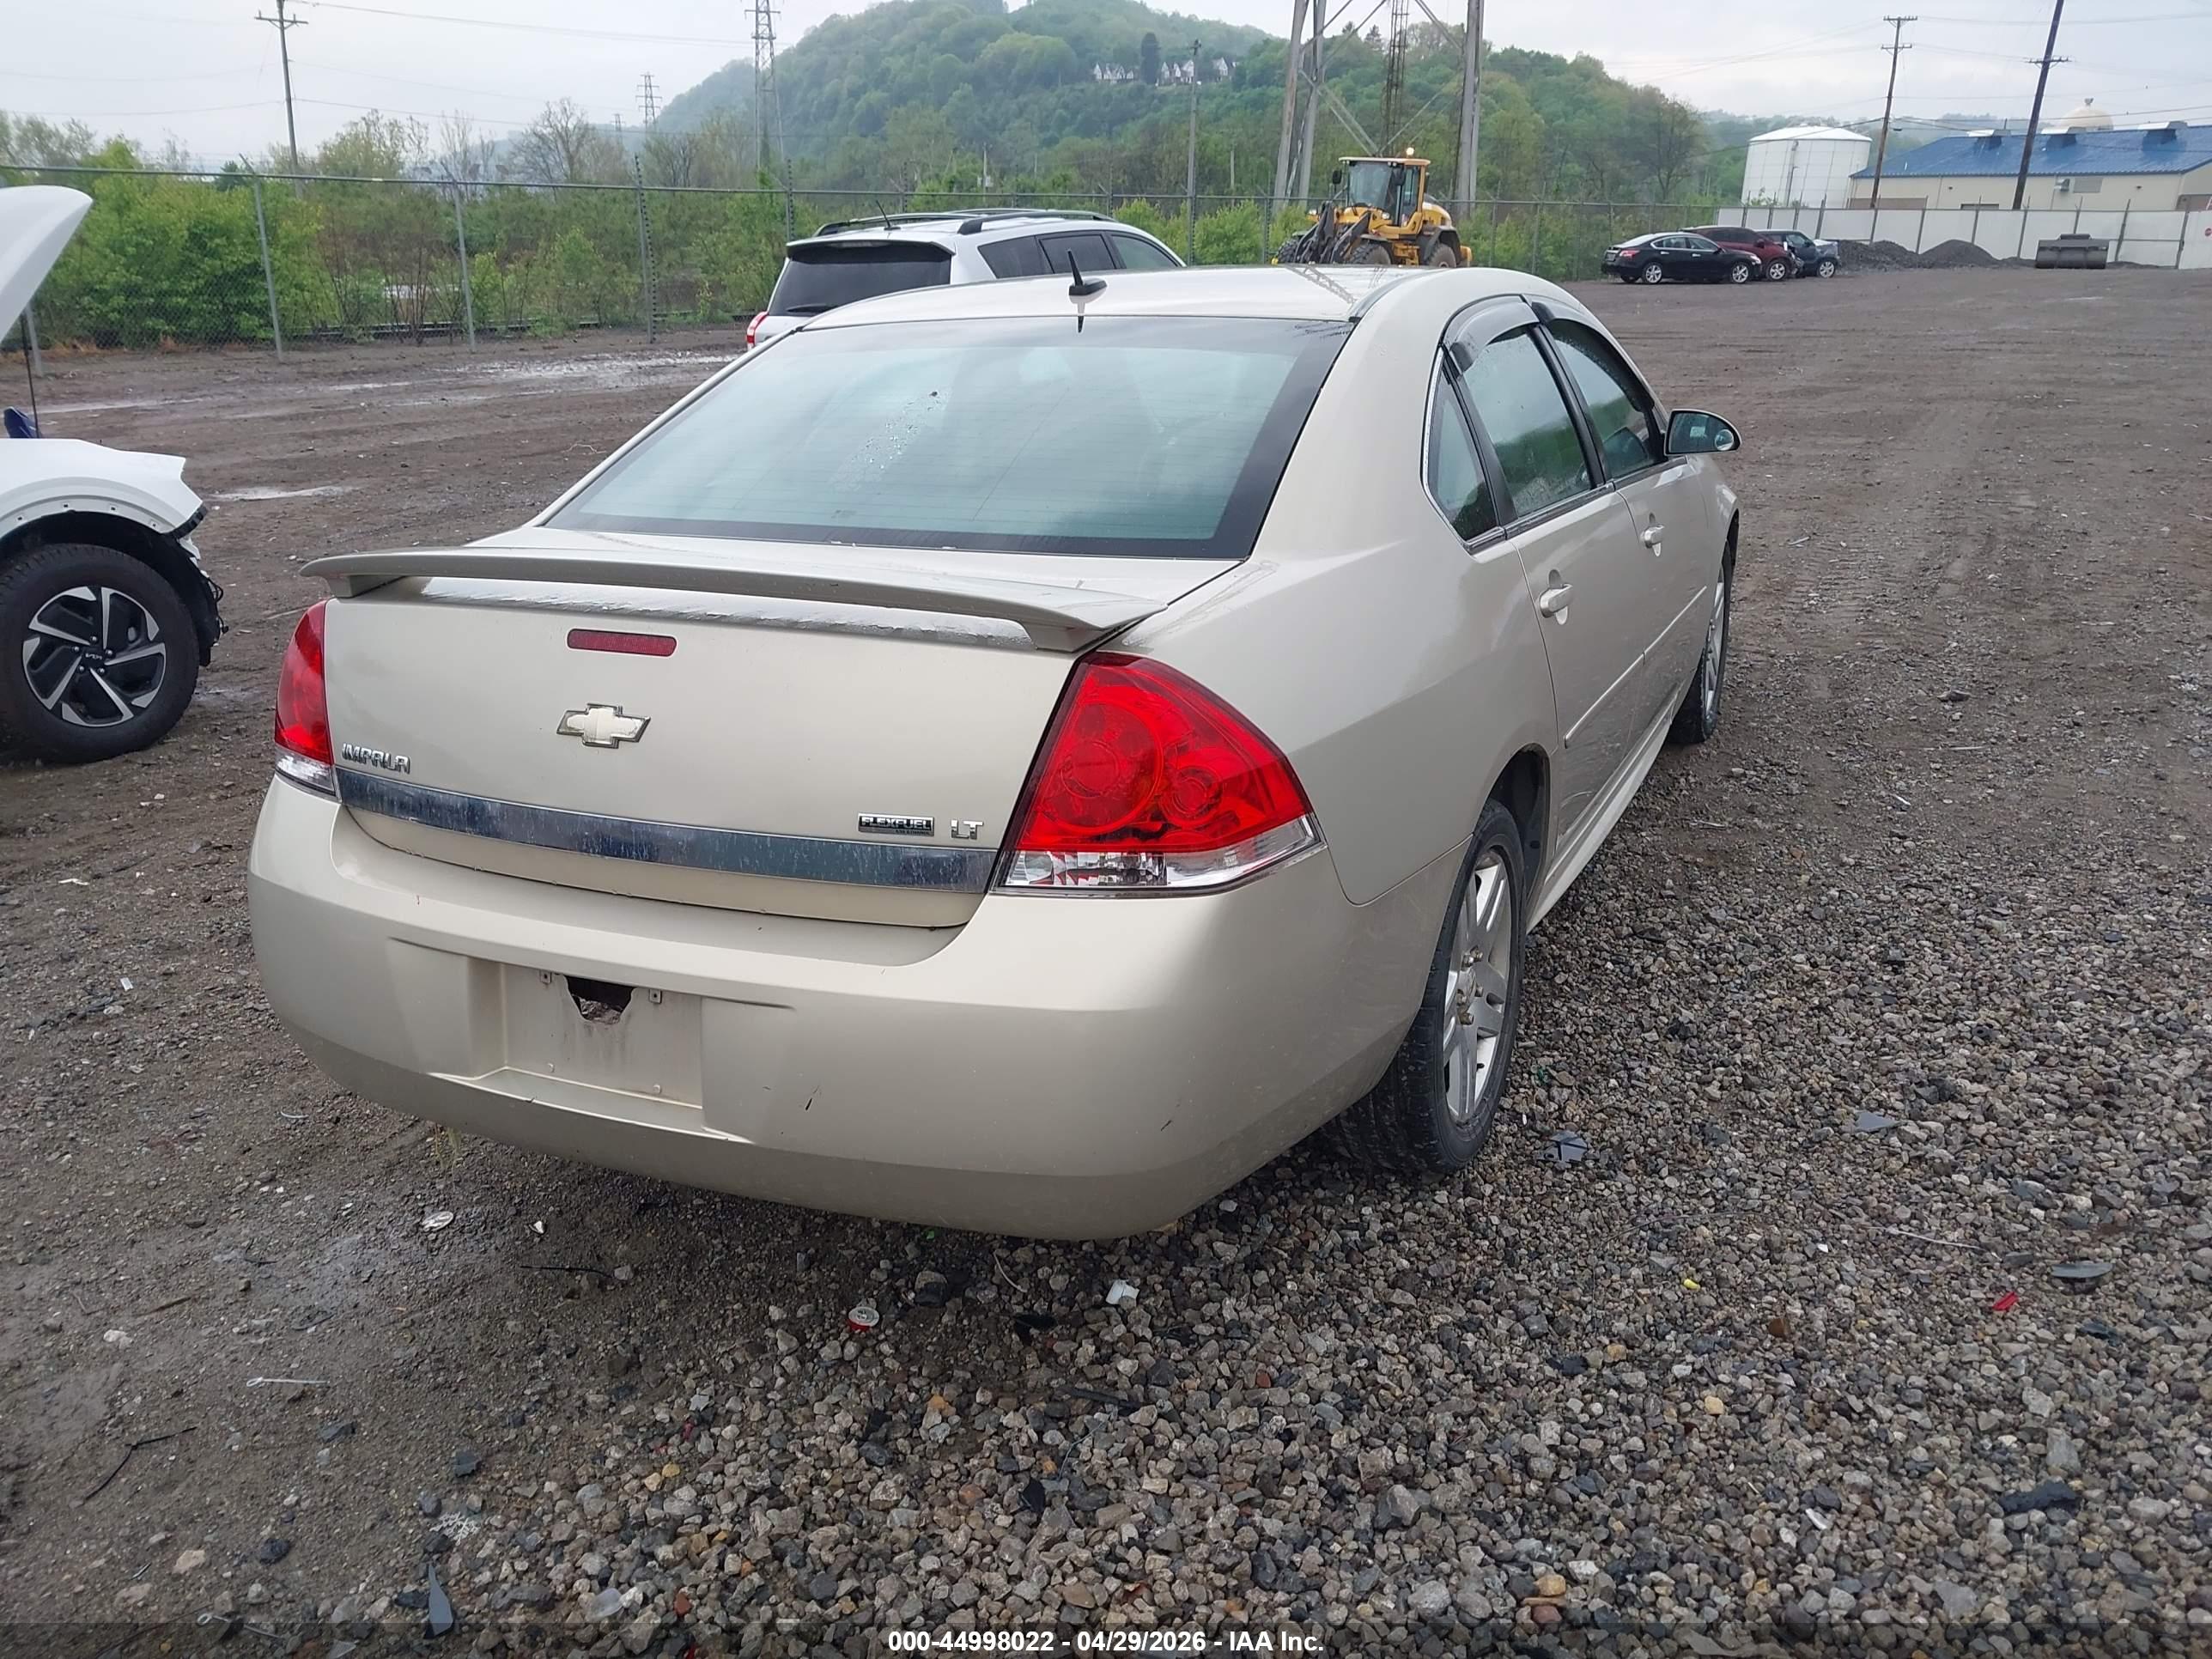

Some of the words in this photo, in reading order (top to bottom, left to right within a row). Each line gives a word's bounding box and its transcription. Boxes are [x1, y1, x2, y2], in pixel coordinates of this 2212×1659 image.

[342, 743, 410, 774] IMPALA
[860, 816, 932, 830] FLEXFUEL
[951, 819, 983, 840] LT
